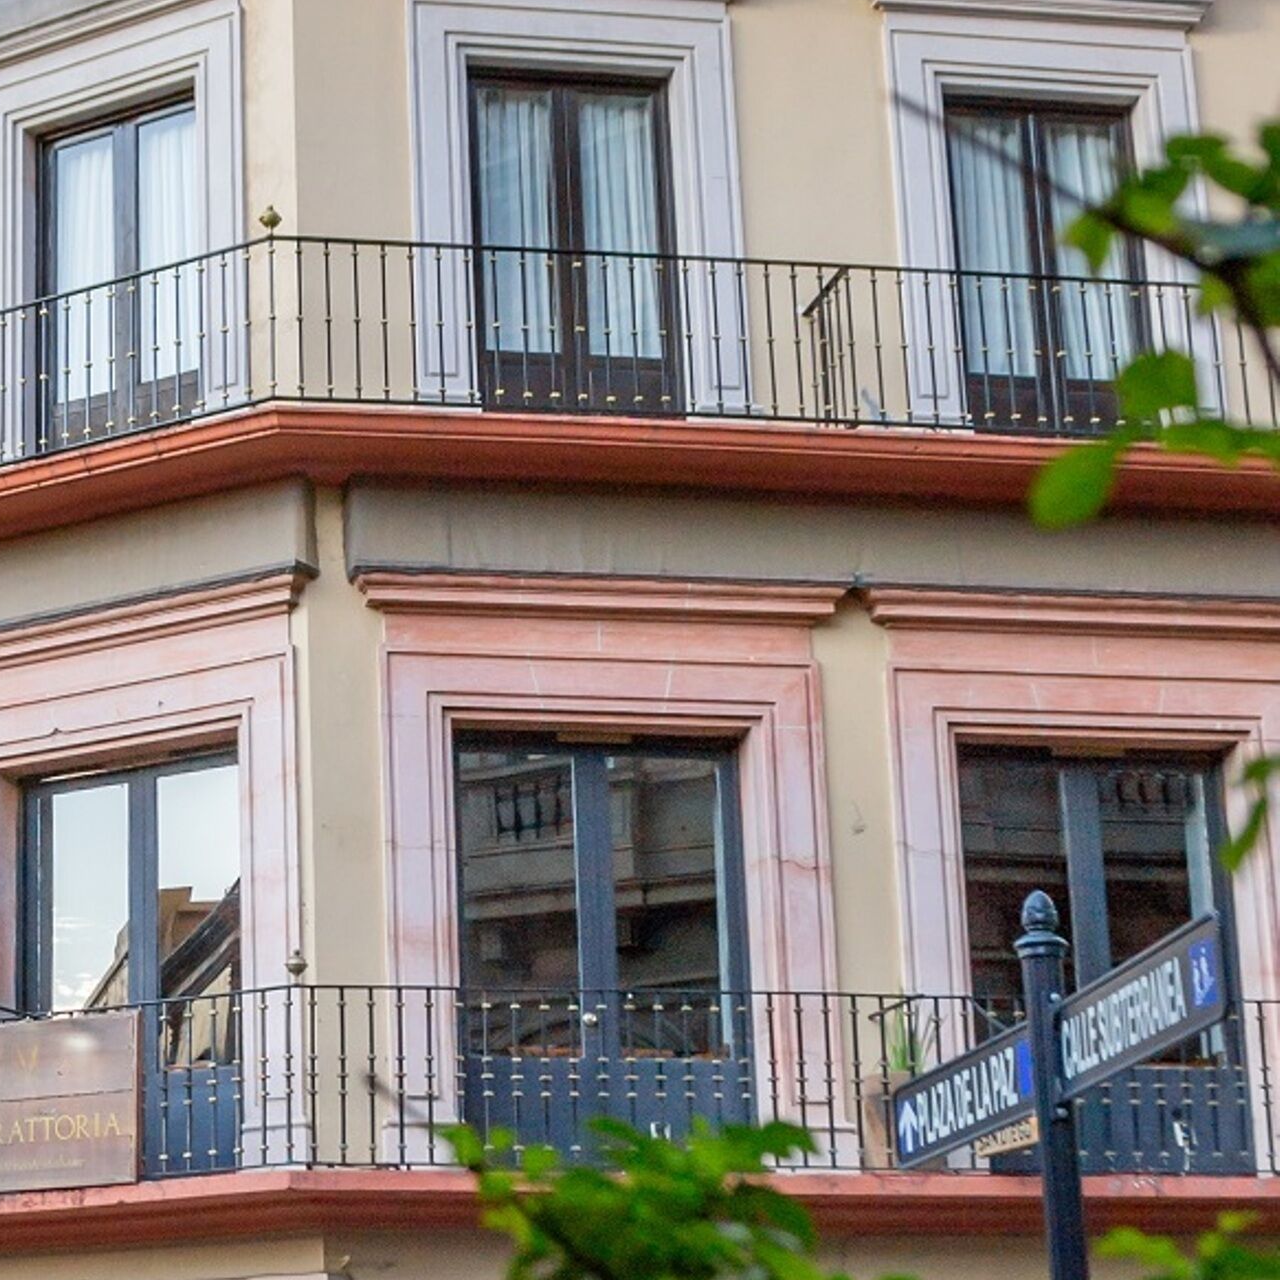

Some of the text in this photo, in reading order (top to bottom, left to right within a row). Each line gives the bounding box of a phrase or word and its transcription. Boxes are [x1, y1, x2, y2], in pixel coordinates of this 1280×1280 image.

[1061, 1005, 1099, 1080] CALLE
[915, 1046, 1019, 1147] PLAZA DE LA PAZ
